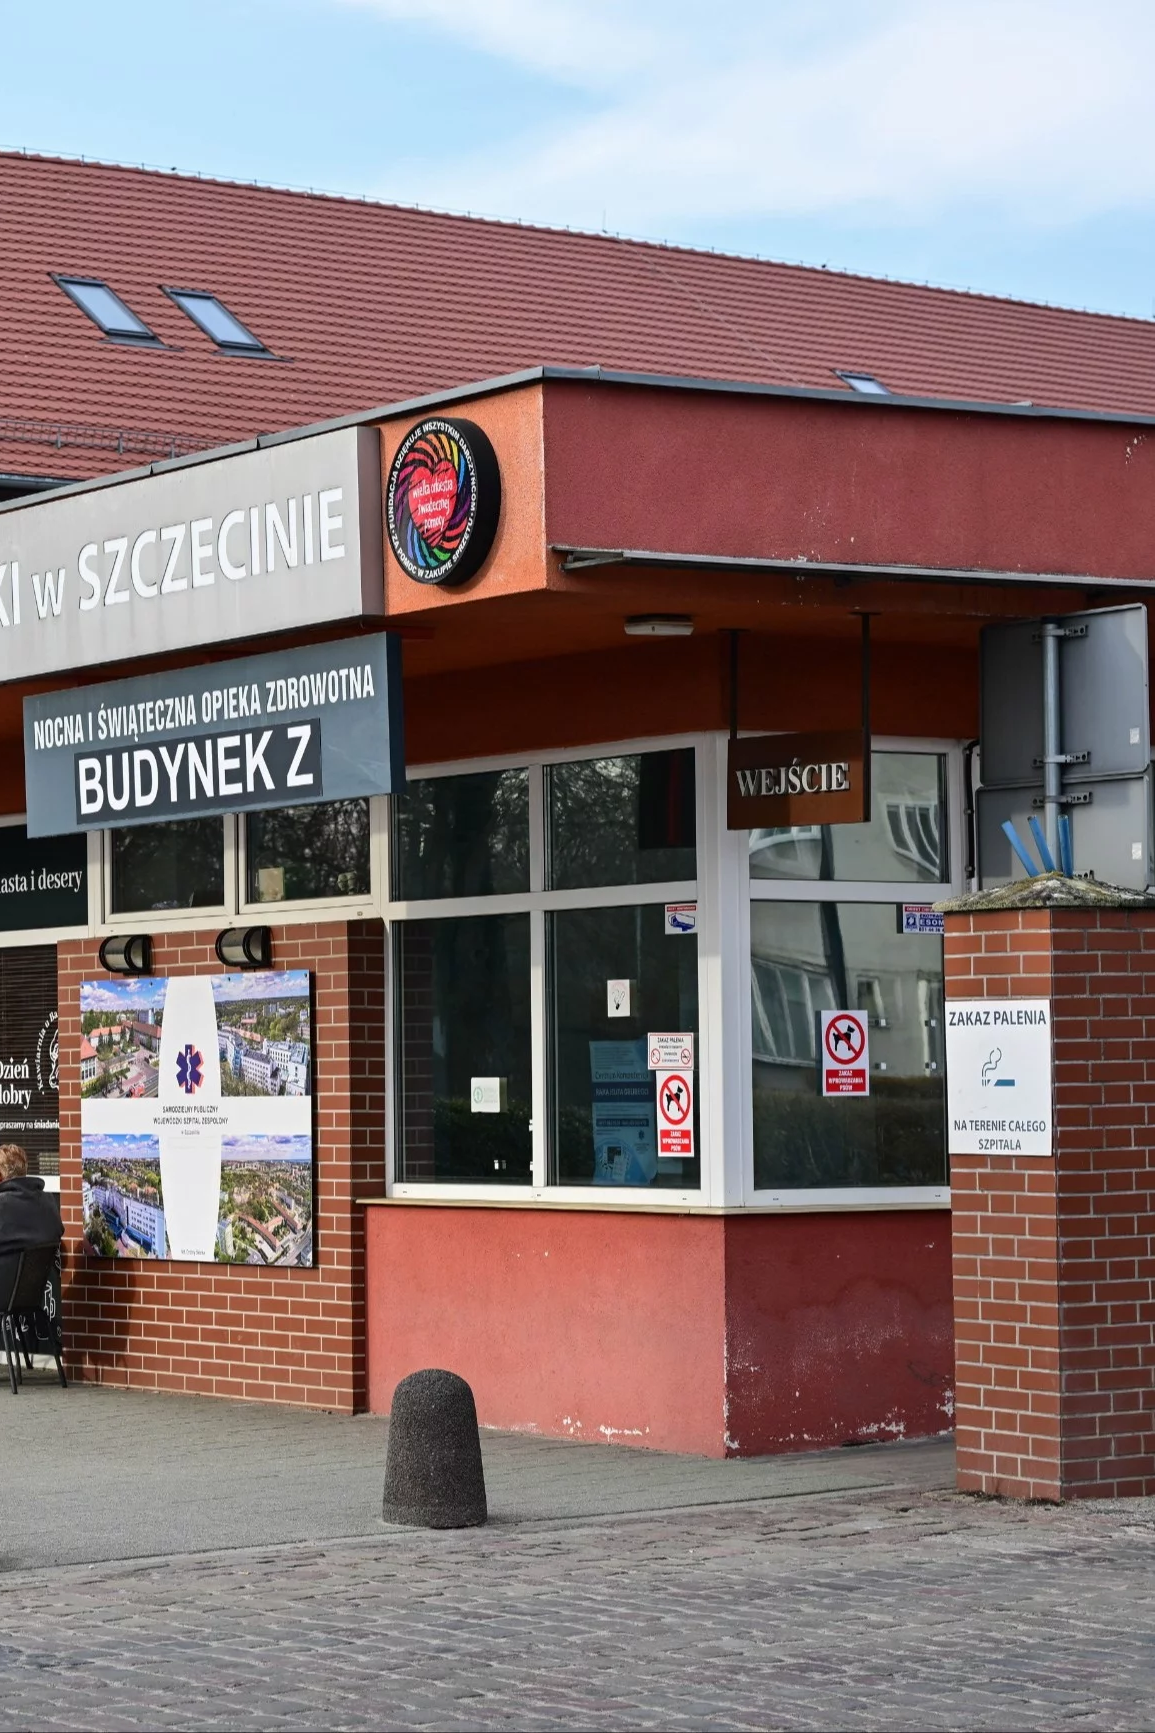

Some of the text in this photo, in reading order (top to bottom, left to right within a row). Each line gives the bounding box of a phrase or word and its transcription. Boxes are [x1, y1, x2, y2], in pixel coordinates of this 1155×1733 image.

[389, 470, 399, 530] FUNDACJA
[423, 421, 460, 442] WSZYSTKIM
[425, 516, 445, 534] pomocy
[31, 568, 66, 620] w
[77, 487, 346, 611] SZCZECINIE
[391, 534, 399, 549] ZA
[397, 547, 417, 574] POMOC
[417, 569, 424, 578] W
[425, 561, 453, 579] ZAKUPIE
[33, 664, 375, 750] NOCNA I ŚWIĄTECZNA OPIEKA ZDROWOTNA
[77, 724, 314, 816] BUDYNEK Z
[735, 757, 851, 798] WEJŚCIE
[30, 870, 35, 891] i
[37, 868, 83, 892] desery
[949, 1010, 1047, 1026] ZAKAZ PALENIA
[954, 1120, 1046, 1132] NA TERENIE CAŁEGO
[978, 1139, 1021, 1150] SZPITALA
